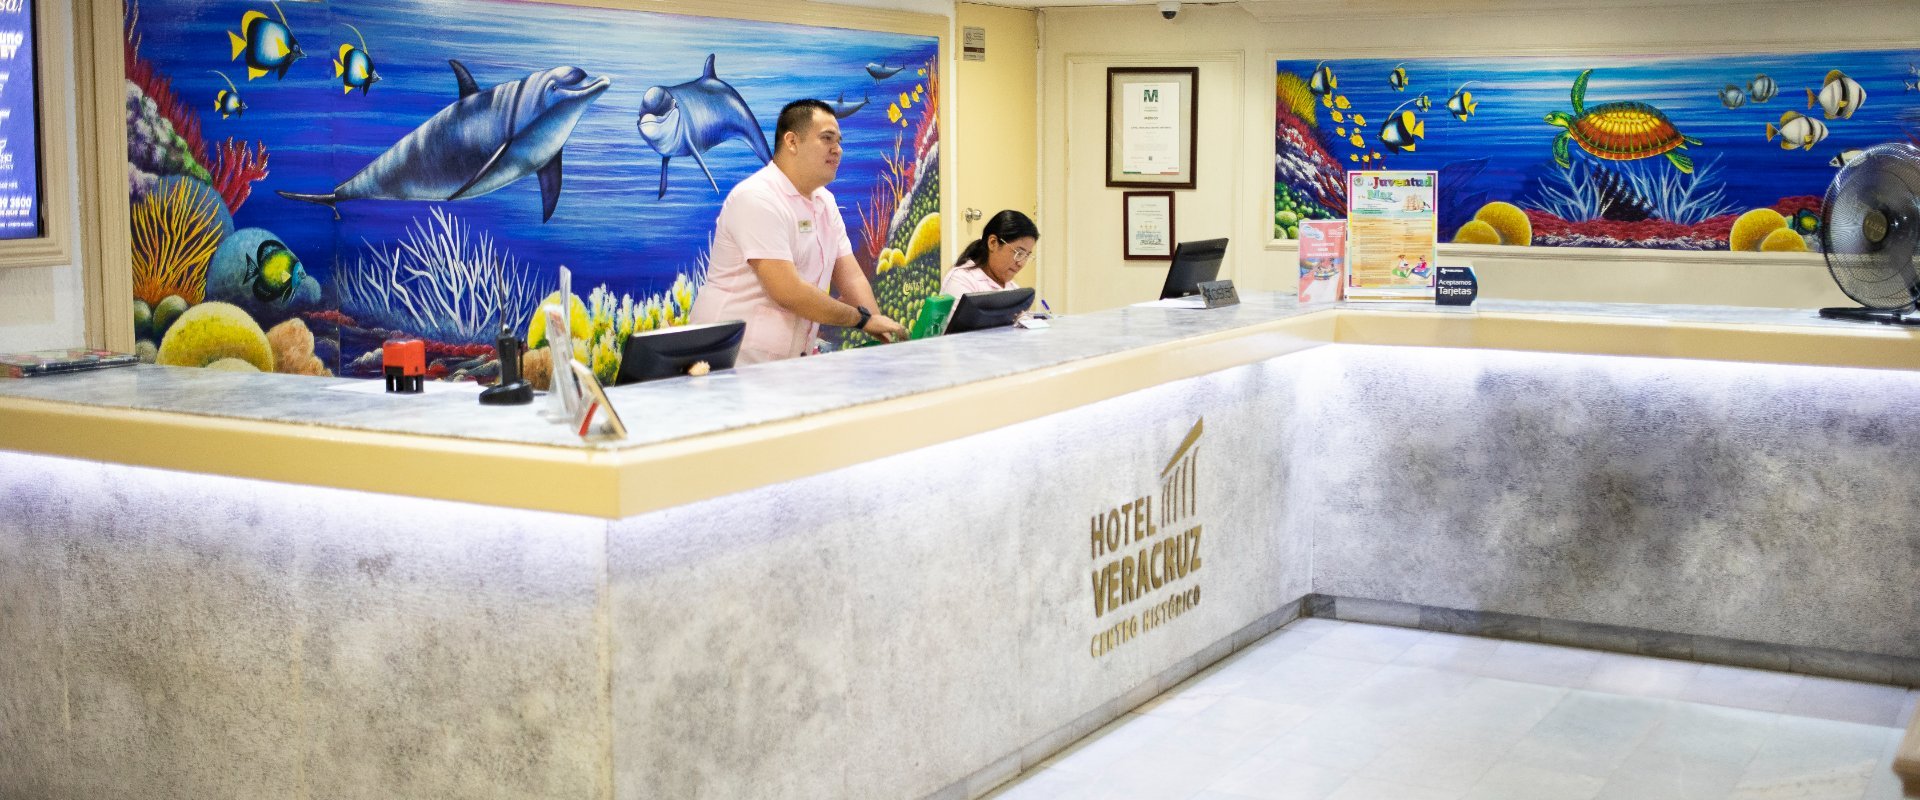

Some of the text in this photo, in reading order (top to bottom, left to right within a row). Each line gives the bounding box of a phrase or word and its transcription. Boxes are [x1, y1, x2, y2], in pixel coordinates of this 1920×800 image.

[1373, 176, 1432, 189] Juventud
[1367, 189, 1392, 200] Mar
[1439, 279, 1472, 287] Aceptamos
[1438, 286, 1472, 296] Tarjetas
[1091, 495, 1157, 560] HOTEL
[1092, 525, 1202, 618] VERACRUZ
[1091, 584, 1201, 658] CENTRO HISTÓRICO
